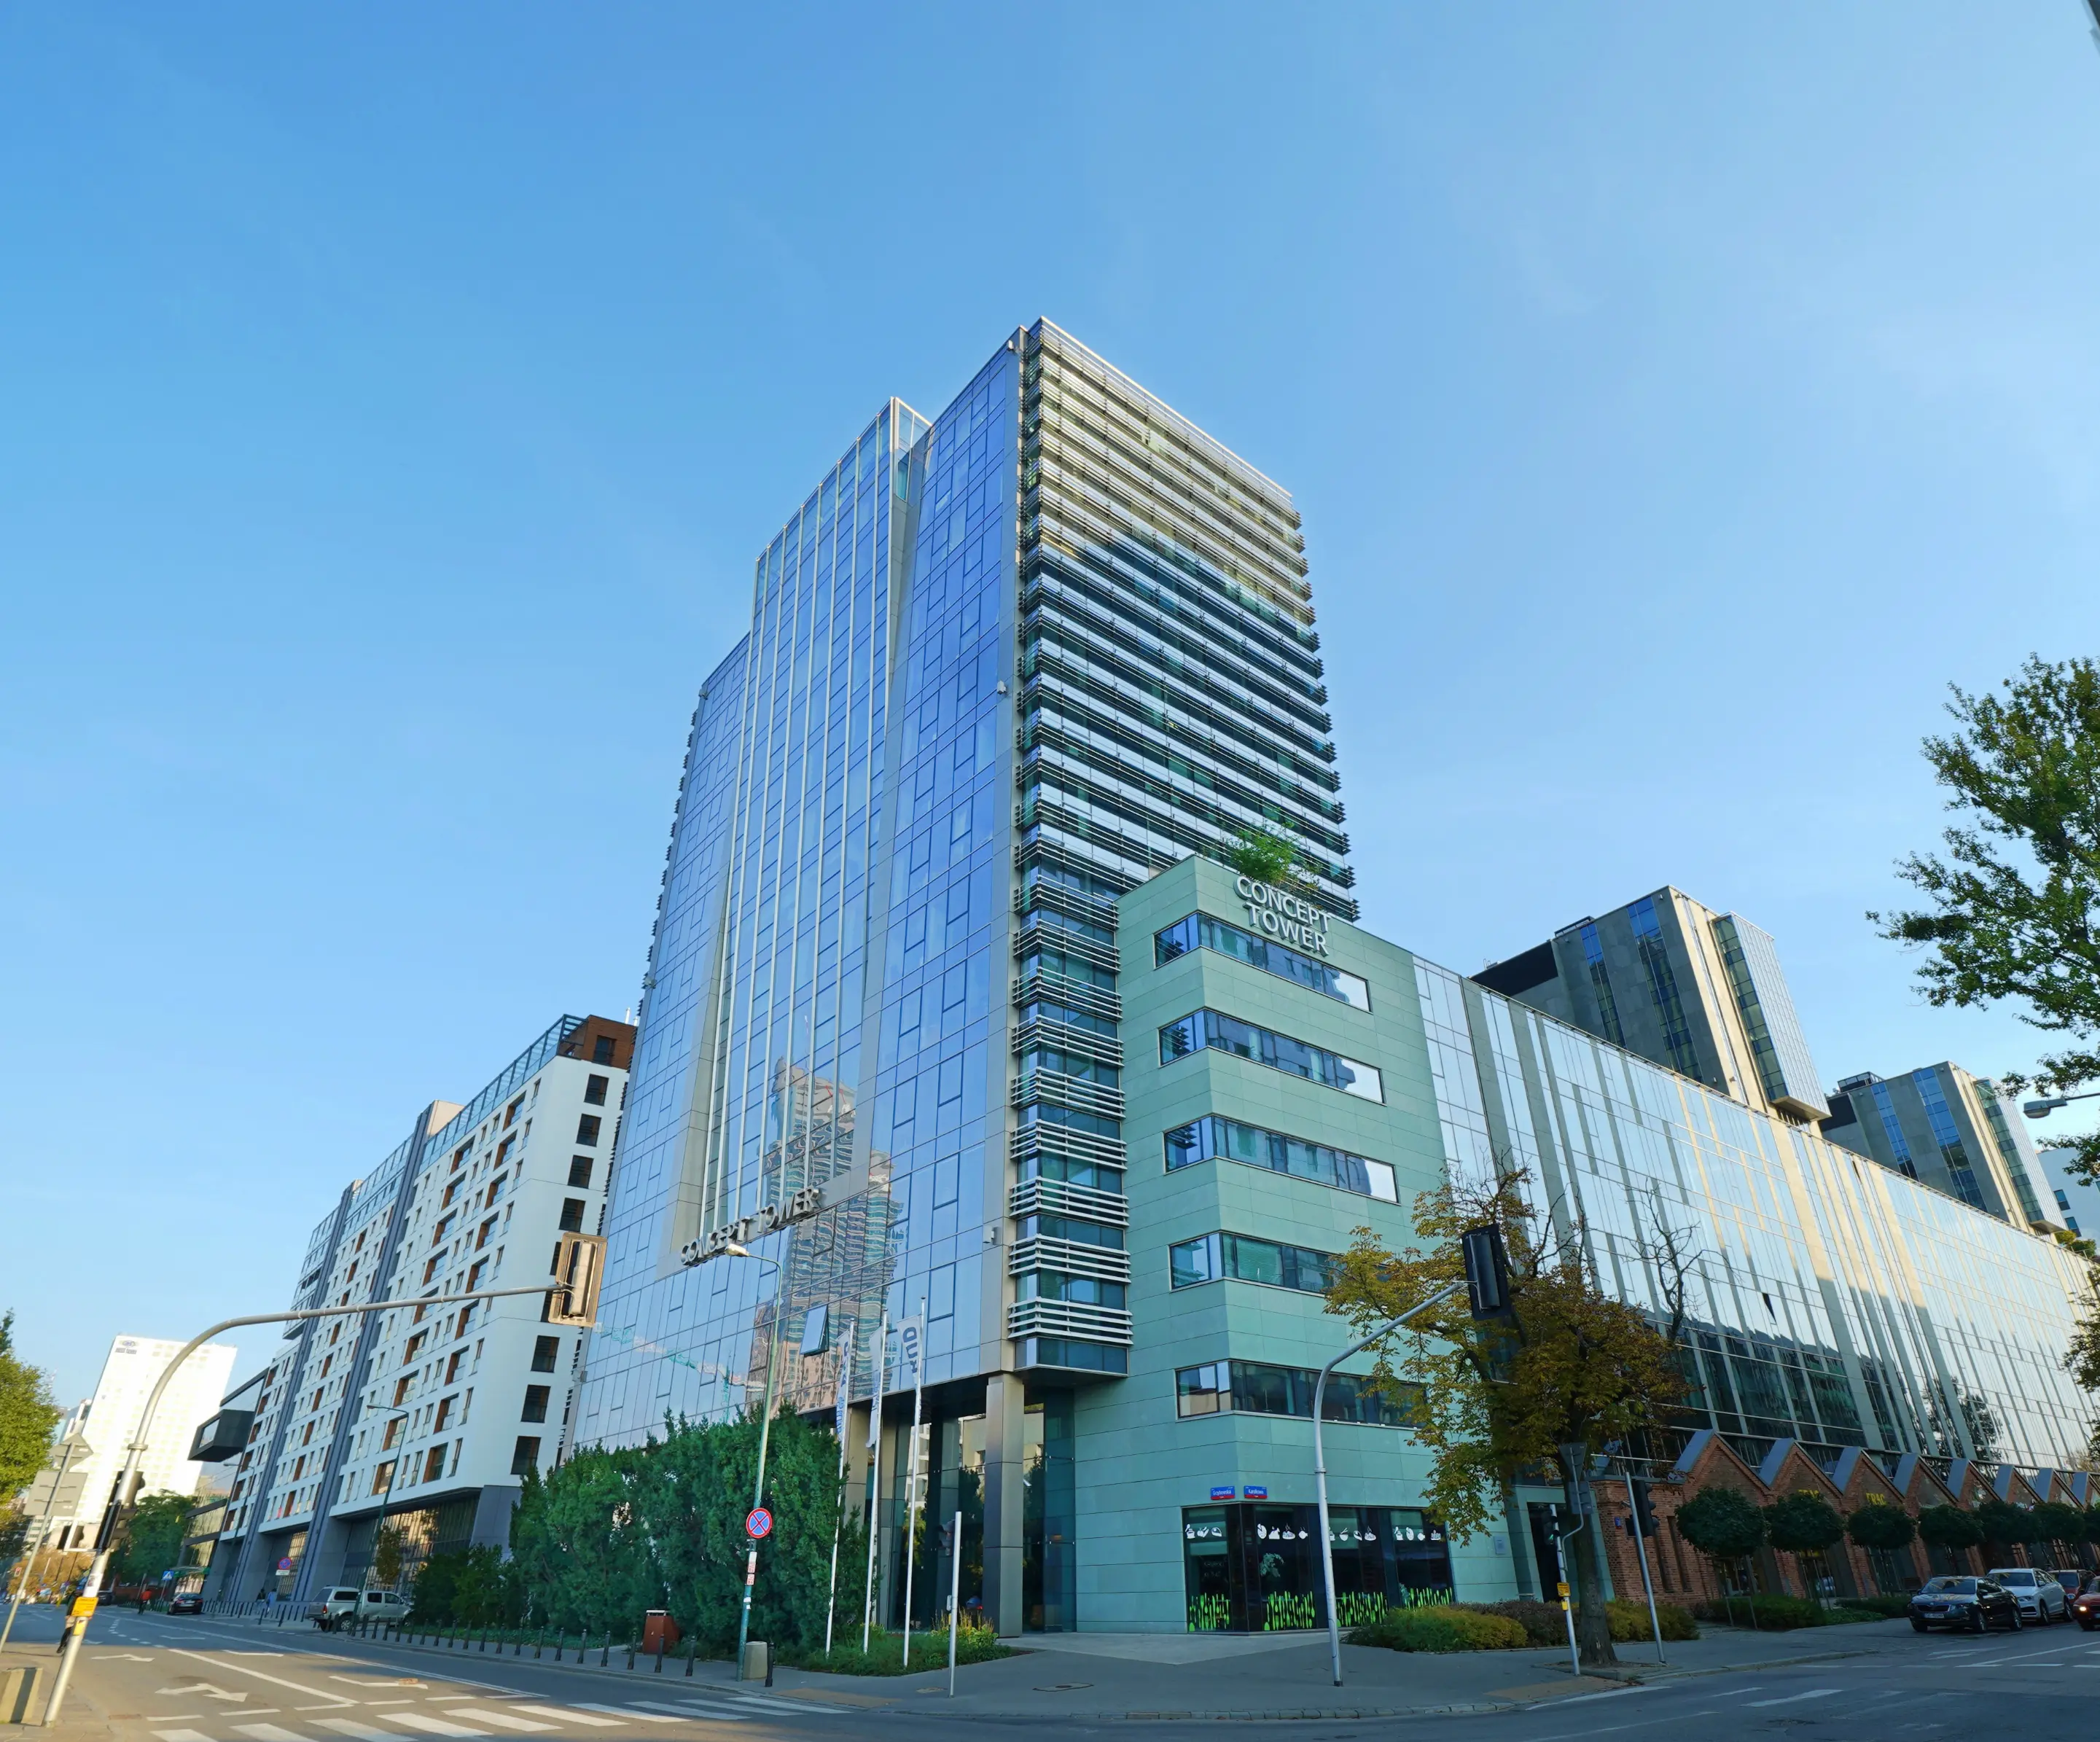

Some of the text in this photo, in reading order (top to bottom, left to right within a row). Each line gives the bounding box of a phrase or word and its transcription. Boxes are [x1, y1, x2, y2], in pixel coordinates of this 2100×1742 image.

[1233, 875, 1330, 934] CONCEPT
[1242, 902, 1330, 957] TOWER
[681, 1185, 819, 1265] CONCEPT TOWER
